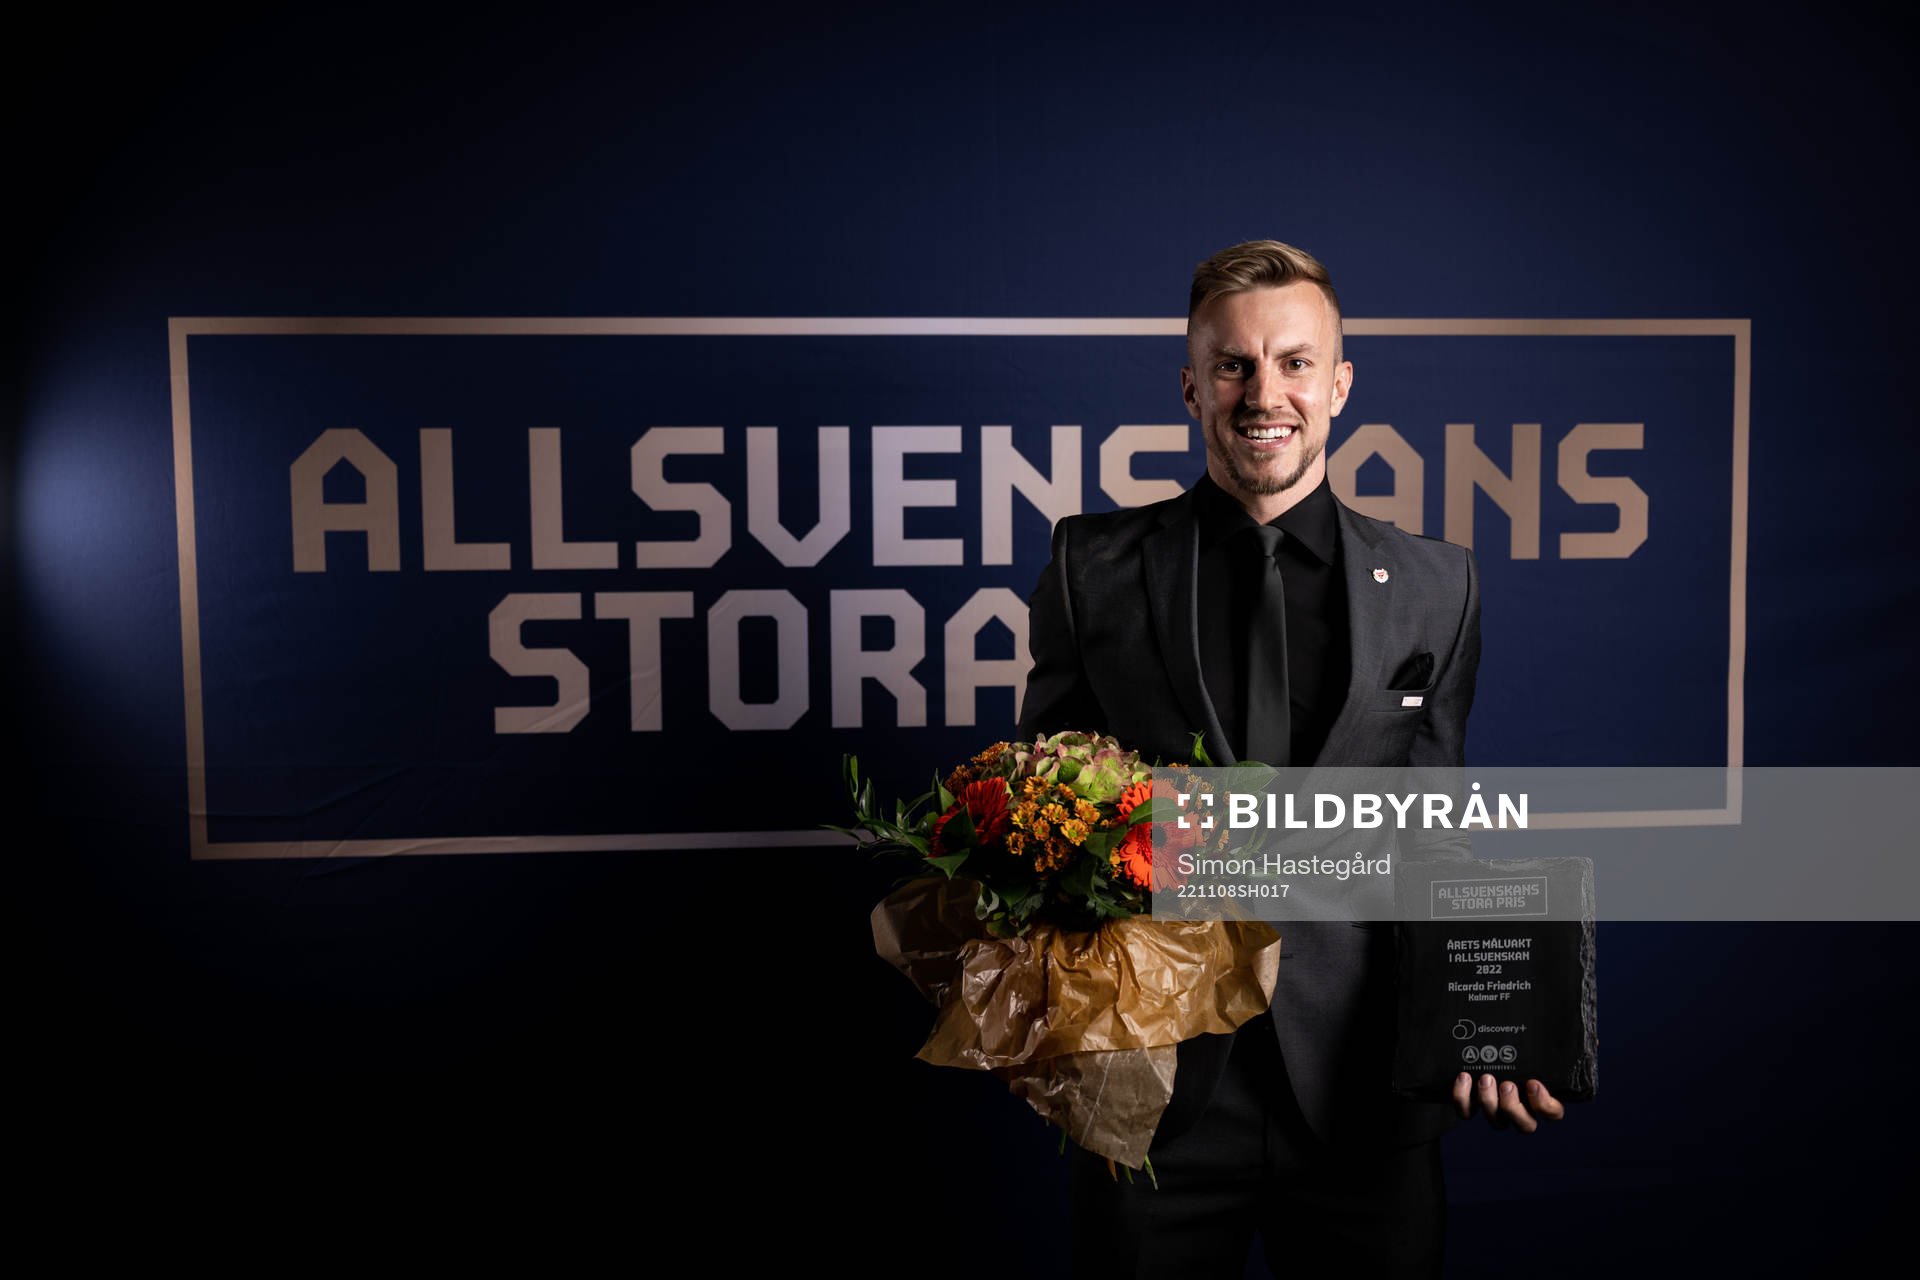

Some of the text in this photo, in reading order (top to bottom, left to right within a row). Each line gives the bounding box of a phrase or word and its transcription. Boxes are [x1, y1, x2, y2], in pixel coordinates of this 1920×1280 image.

[290, 423, 1649, 573] ALLSVENSANS
[488, 587, 1035, 734] STORA
[1438, 884, 1540, 899] ALLSVENSKANS
[1452, 896, 1526, 910] STORA PRIS
[1447, 938, 1532, 950] ÅRETS MÅLVAKT
[1454, 951, 1530, 963] ALLSVENSKAN
[1476, 964, 1502, 975] 2022
[1448, 980, 1531, 992] Ricardo Friedrich
[1468, 992, 1511, 1002] Kalmar FF
